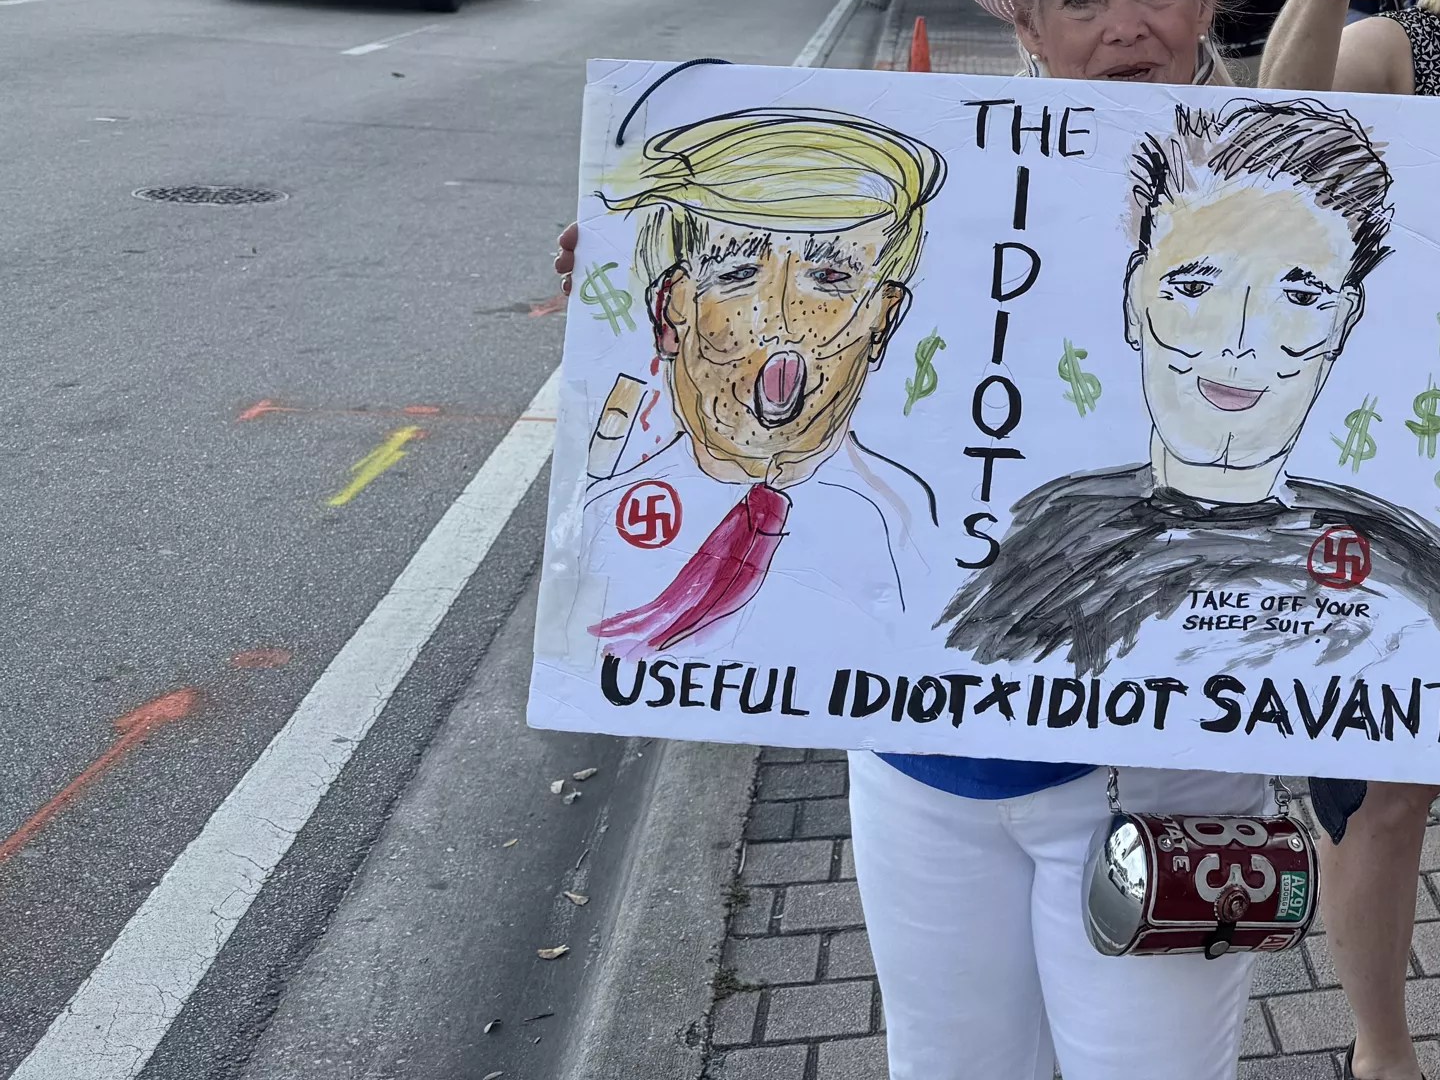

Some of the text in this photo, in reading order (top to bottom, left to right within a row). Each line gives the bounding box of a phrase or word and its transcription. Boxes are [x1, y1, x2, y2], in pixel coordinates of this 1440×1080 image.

[961, 98, 1095, 157] THE
[1182, 615, 1257, 631] SHEEP
[1187, 590, 1370, 618] TAKE OFF YOUR
[600, 653, 810, 716] USEFUL
